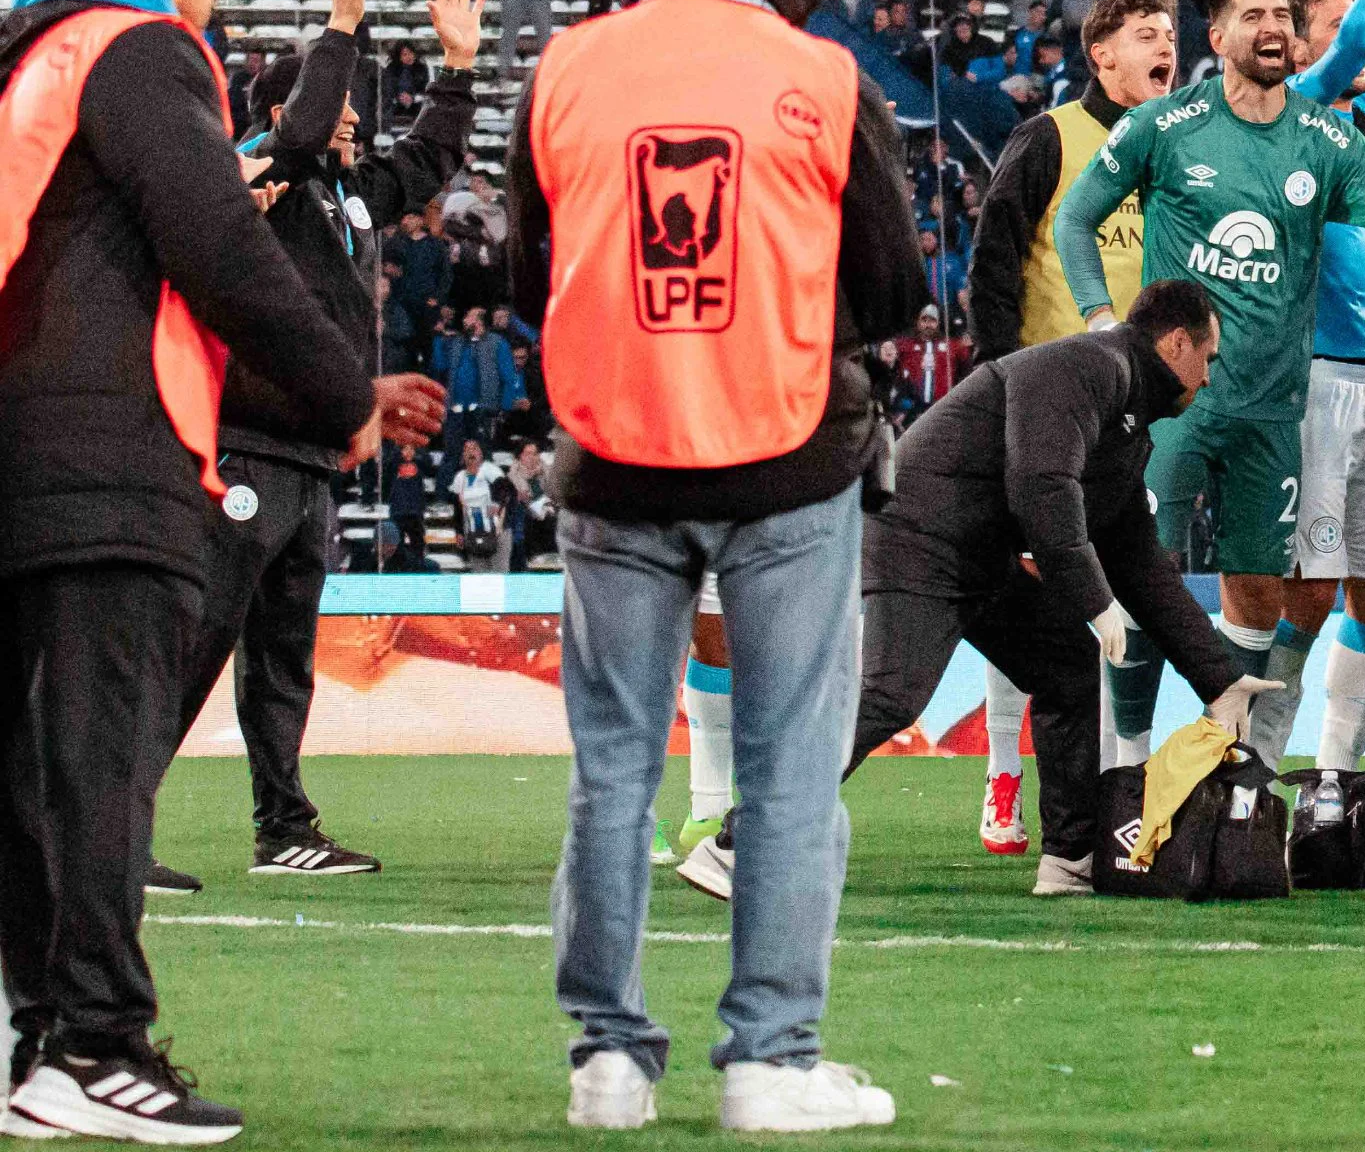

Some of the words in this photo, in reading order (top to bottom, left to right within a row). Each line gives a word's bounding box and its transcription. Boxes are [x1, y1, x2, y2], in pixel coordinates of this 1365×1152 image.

[1155, 99, 1210, 132] SANOS
[1300, 113, 1350, 149] SANOS
[1187, 243, 1280, 283] Macro
[644, 277, 726, 321] LPF
